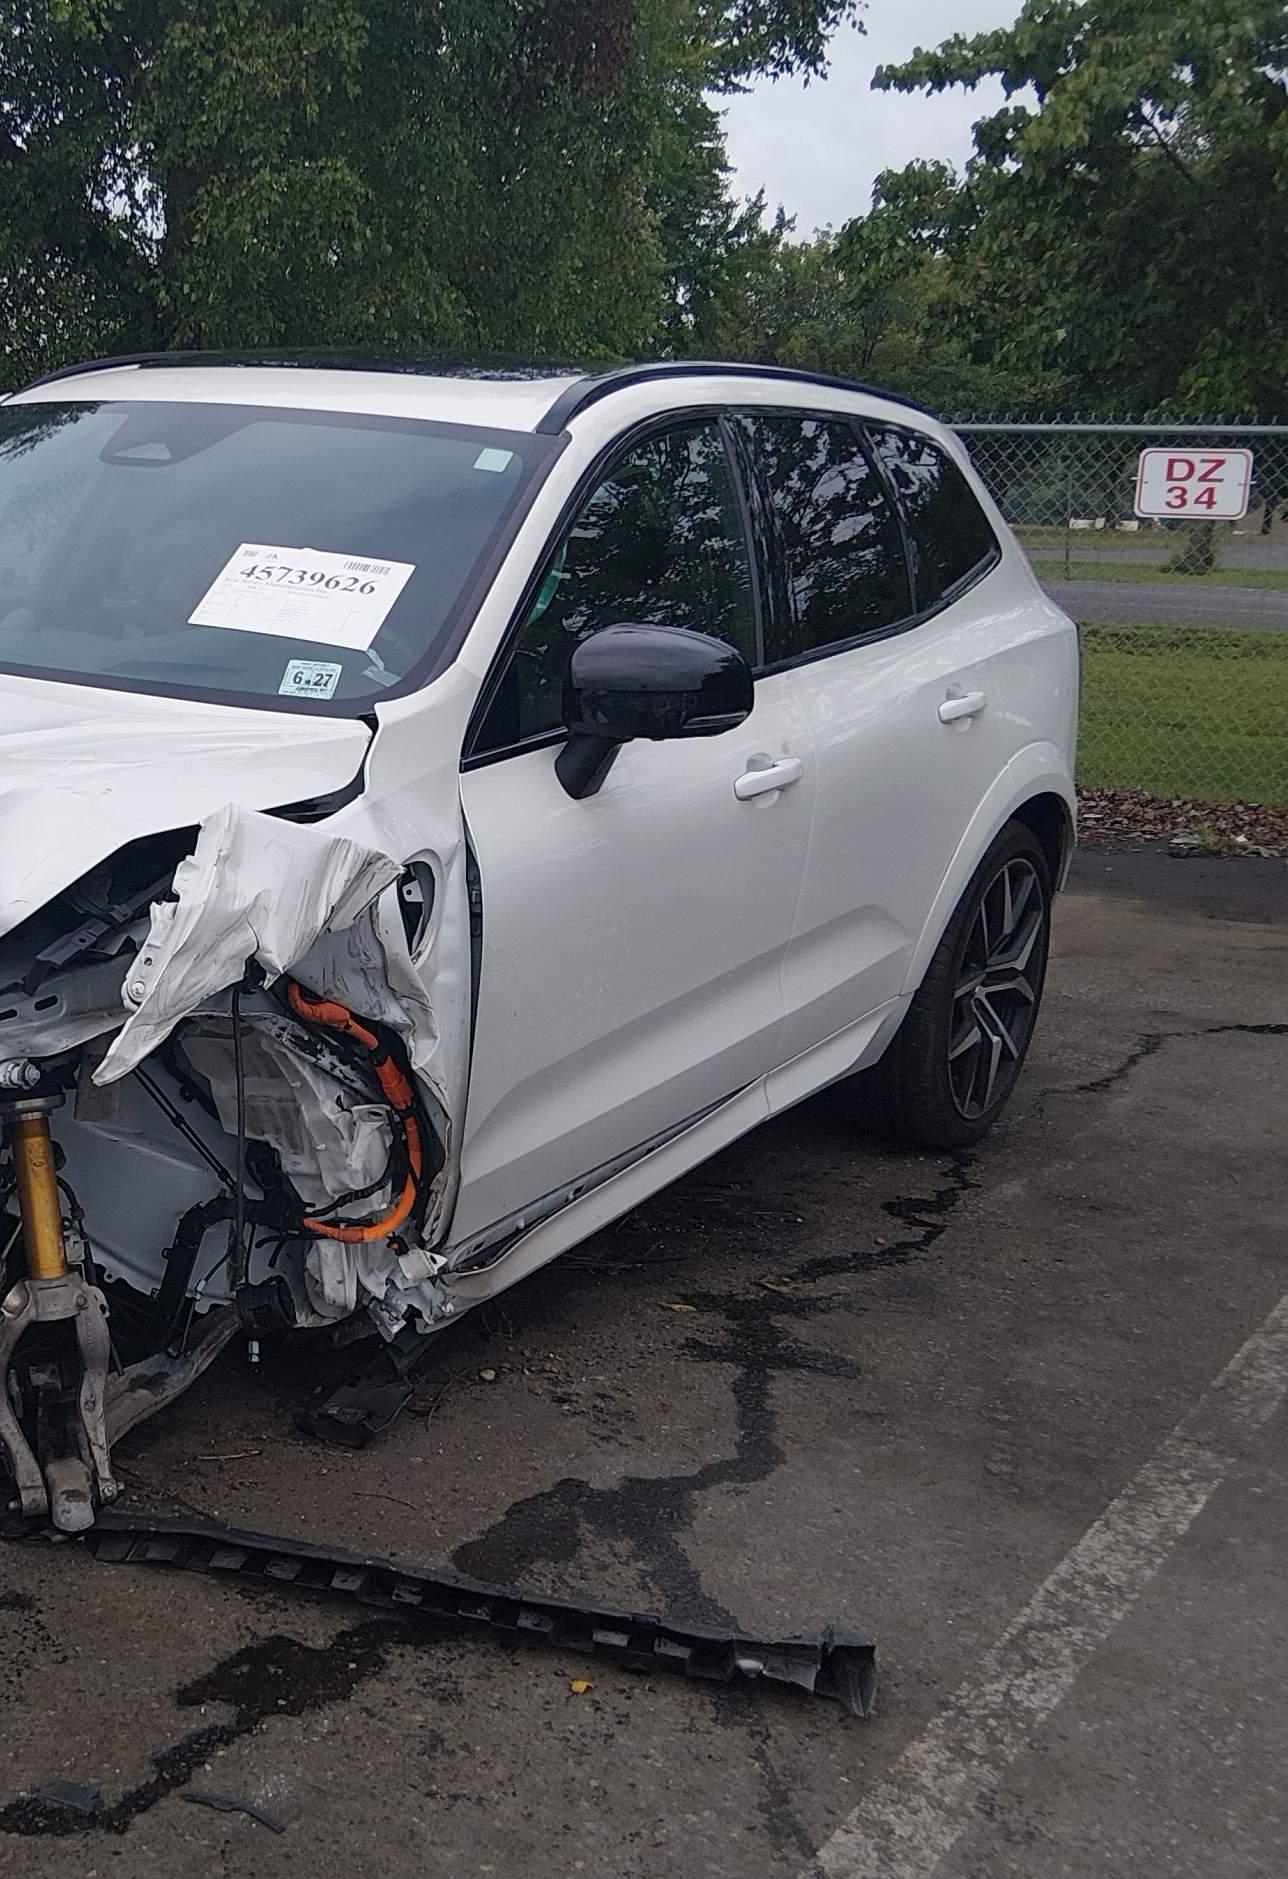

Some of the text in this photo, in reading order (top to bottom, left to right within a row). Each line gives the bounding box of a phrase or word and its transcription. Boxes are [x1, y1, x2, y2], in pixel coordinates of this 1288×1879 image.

[1165, 458, 1226, 483] DZ
[1165, 486, 1217, 510] 34
[240, 563, 381, 595] 45739626
[292, 671, 334, 687] 6 27
